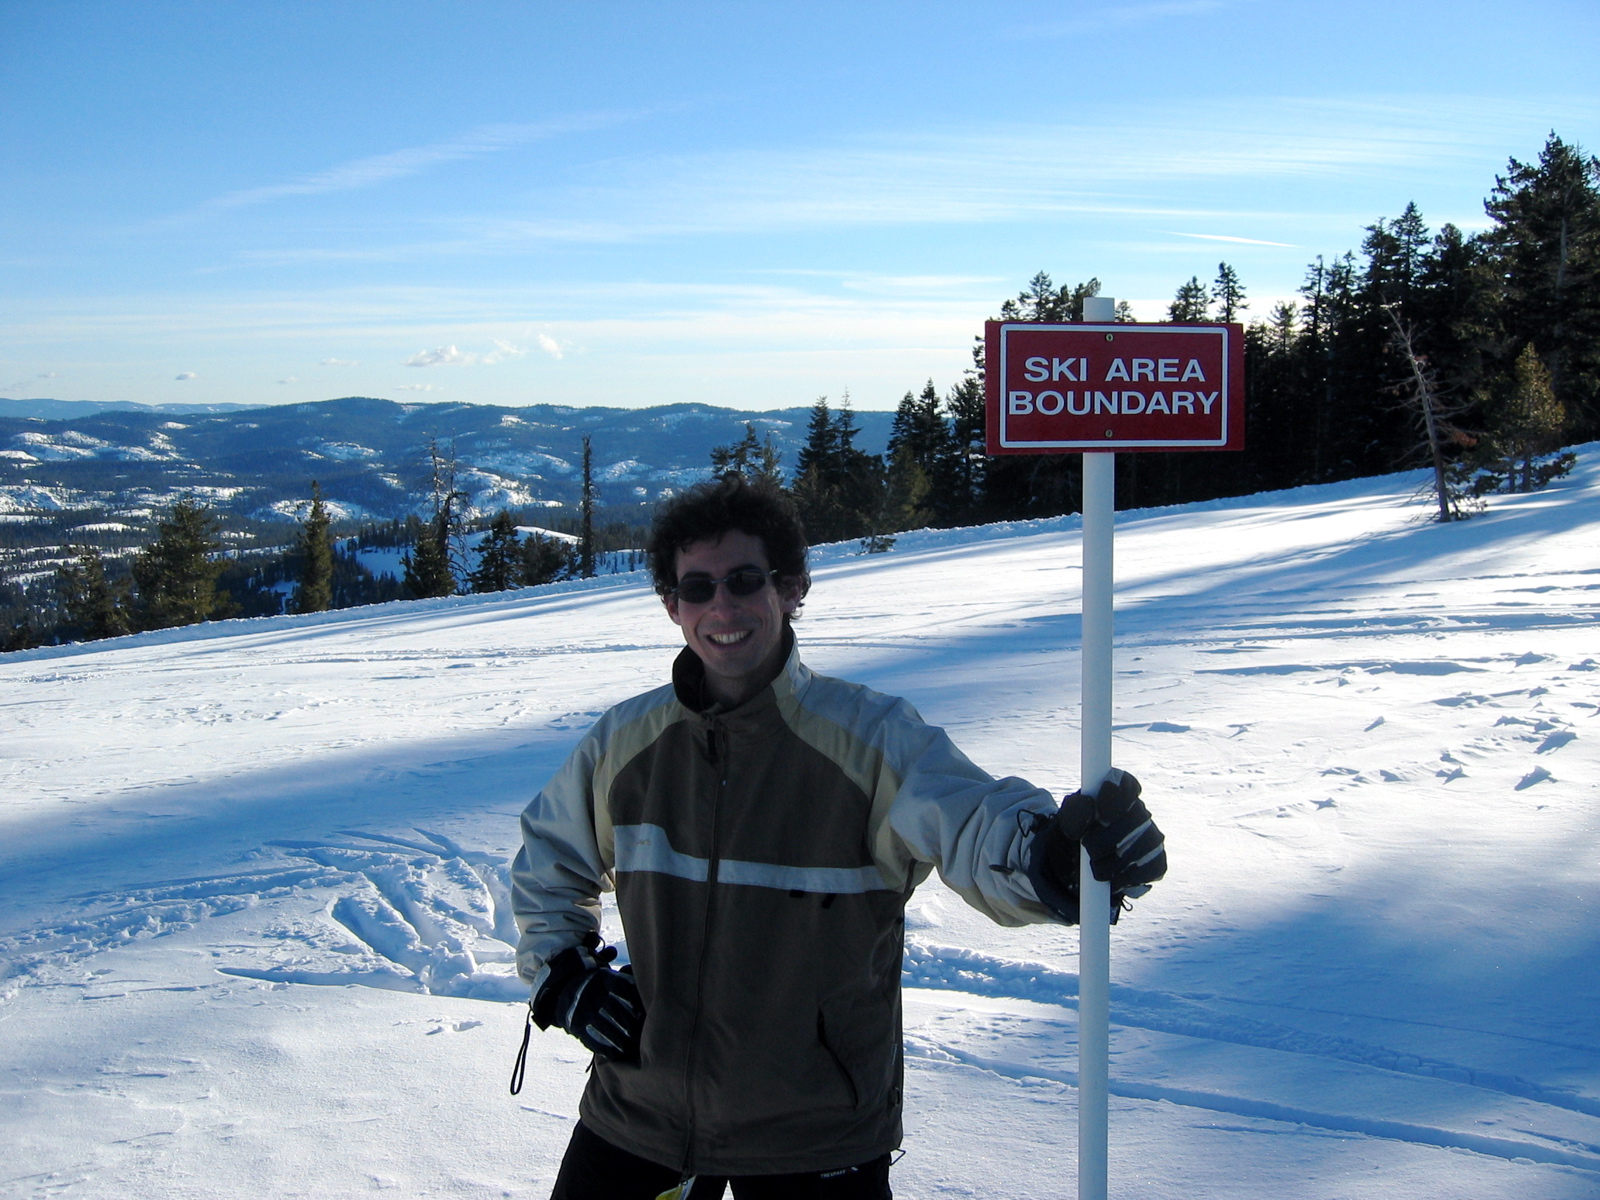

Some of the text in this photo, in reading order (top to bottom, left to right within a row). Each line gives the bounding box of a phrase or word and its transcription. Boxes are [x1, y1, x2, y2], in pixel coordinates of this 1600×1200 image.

[1024, 357, 1205, 382] SKI AREA
[1009, 391, 1219, 415] BOUNDARY
